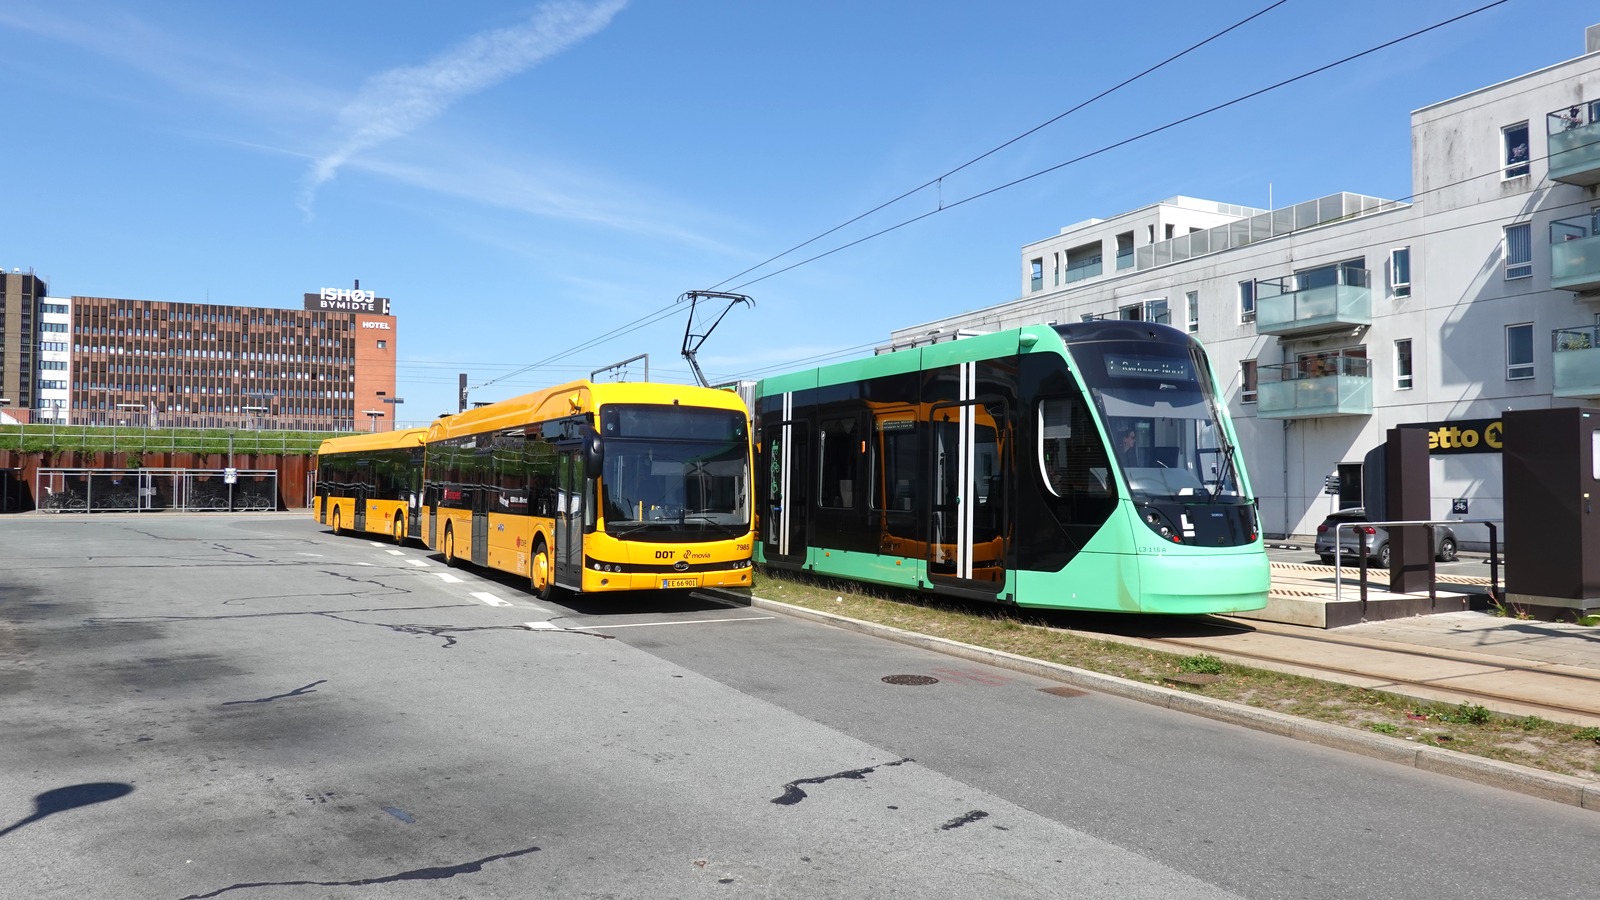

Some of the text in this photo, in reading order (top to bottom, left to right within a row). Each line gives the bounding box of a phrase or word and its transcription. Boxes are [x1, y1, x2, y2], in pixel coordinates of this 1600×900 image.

[320, 287, 375, 303] ISHØJ
[320, 300, 375, 311] BYMIDTE
[362, 321, 390, 329] HOTEL
[736, 543, 750, 551] 7985
[655, 550, 675, 559] DOT
[685, 579, 696, 587] 901
